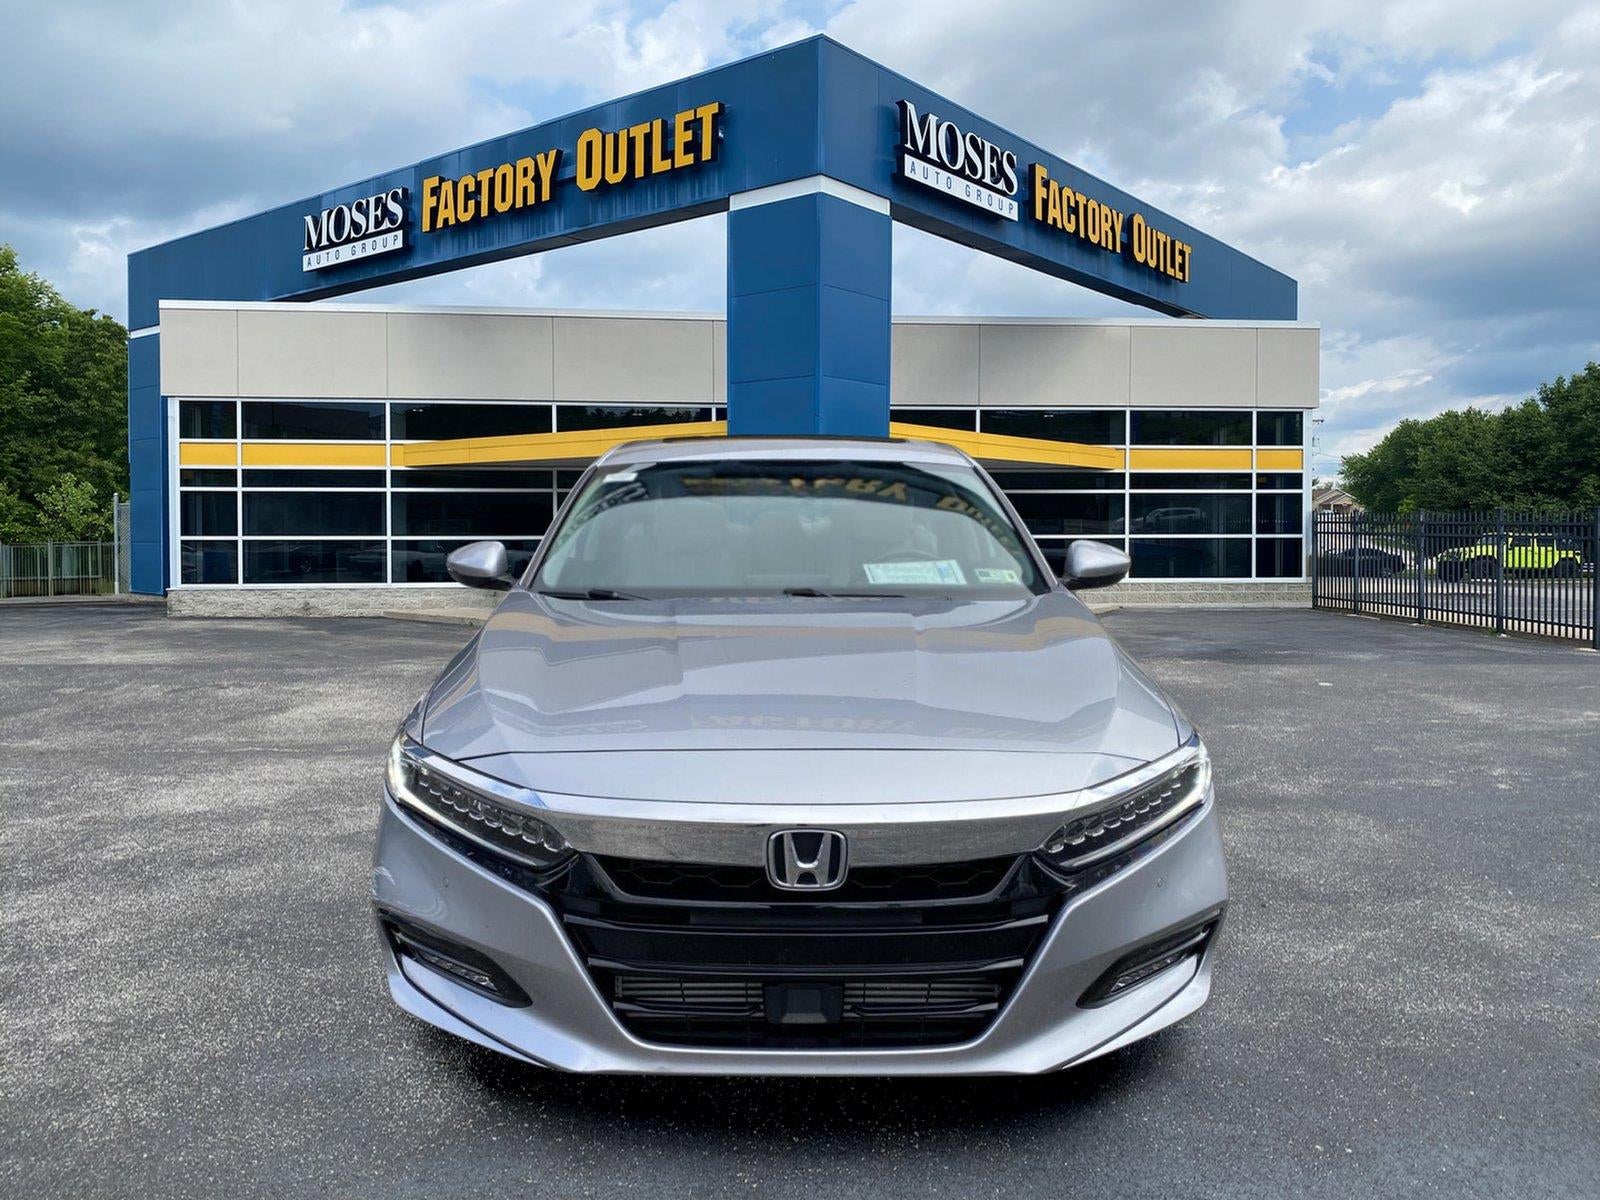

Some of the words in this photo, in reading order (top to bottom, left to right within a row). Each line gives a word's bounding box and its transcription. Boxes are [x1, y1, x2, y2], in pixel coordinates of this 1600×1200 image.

[421, 149, 558, 233] FACTORY
[576, 101, 720, 192] OUTLET
[904, 99, 1018, 196] MOSES
[909, 161, 953, 190] AUTO
[965, 181, 1014, 214] GROUP
[303, 187, 403, 251] MOSES
[307, 249, 340, 268] AUTO
[351, 234, 399, 256] GROUP
[1034, 163, 1123, 254] FACTORY
[1131, 212, 1192, 283] OUTLET
